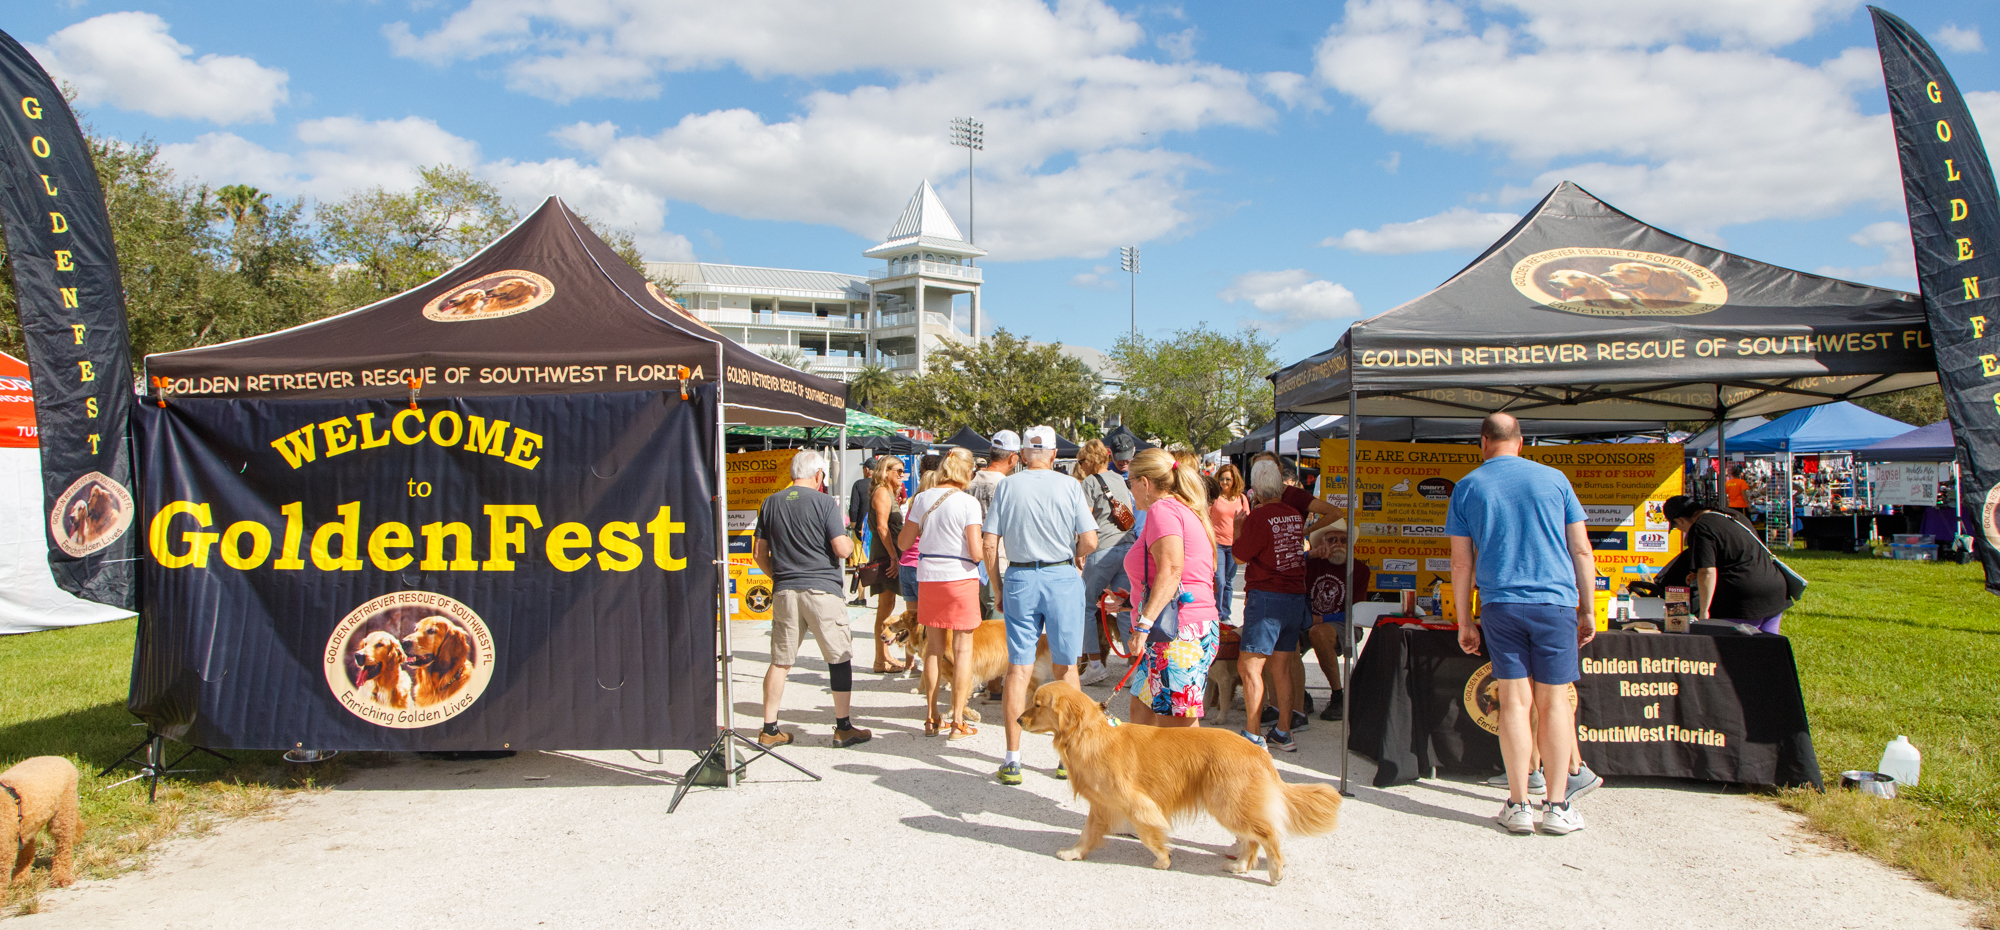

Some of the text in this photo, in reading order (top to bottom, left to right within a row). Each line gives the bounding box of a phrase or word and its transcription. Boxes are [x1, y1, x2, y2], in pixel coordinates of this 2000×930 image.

[1515, 264, 1531, 287] GOLDEN
[1528, 249, 1577, 266] RETRIEVER
[1578, 249, 1623, 257] RESCUE
[1646, 254, 1713, 283] SOUTHWEST
[1709, 279, 1720, 289] FL
[1548, 300, 1626, 316] Enriching
[1362, 330, 1931, 368] GOLDEN RETRIEVER RESCUE OF SOUTHWEST FL
[165, 376, 239, 395] GOLDEN
[246, 371, 355, 392] RETRIEVER
[361, 366, 436, 387] RESCUE
[444, 366, 471, 384] OF
[479, 365, 607, 384] SOUTHWEST
[727, 365, 751, 386] GOLDEN
[752, 371, 780, 392] RETRIEVER
[780, 377, 798, 396] RESCUE
[797, 384, 805, 397] OF
[805, 387, 829, 406] SOUTHWEST
[271, 407, 544, 471] WELCOME
[1375, 450, 1404, 462] ARE
[1409, 452, 1484, 463] GRATEFUL
[1541, 453, 1655, 465] OUR SPONSORS
[732, 475, 778, 484] OF SHOW
[1328, 466, 1441, 476] HEAT OF A GOLDEN
[1575, 470, 1656, 478] BEST OF SHOW
[1876, 465, 1901, 481] Damsel
[407, 477, 432, 498] to
[742, 487, 780, 495] Foundation
[1584, 481, 1614, 489] Burruss
[1616, 481, 1660, 489] Foundation
[52, 499, 66, 525] GOLDEN
[65, 477, 88, 500] RETRIEVER
[99, 475, 131, 505] SOUTHWEST
[1616, 492, 1639, 501] Family
[1984, 501, 1995, 529] GOLDEN
[102, 528, 123, 546] Lives
[148, 500, 688, 573] GoldenFest
[1378, 546, 1395, 555] OF
[1630, 556, 1655, 564] VIPs
[326, 593, 493, 666] GOLDEN RETRIEVER RESCUE OF SOUTHWEST FL
[1582, 656, 1717, 676] Golden Retriever
[1465, 677, 1479, 702] GOLDEN
[1619, 680, 1679, 697] Rescue
[340, 690, 474, 726] Enriching Golden Lives
[1643, 702, 1660, 719] of
[1578, 724, 1726, 747] SouthWest Florida
